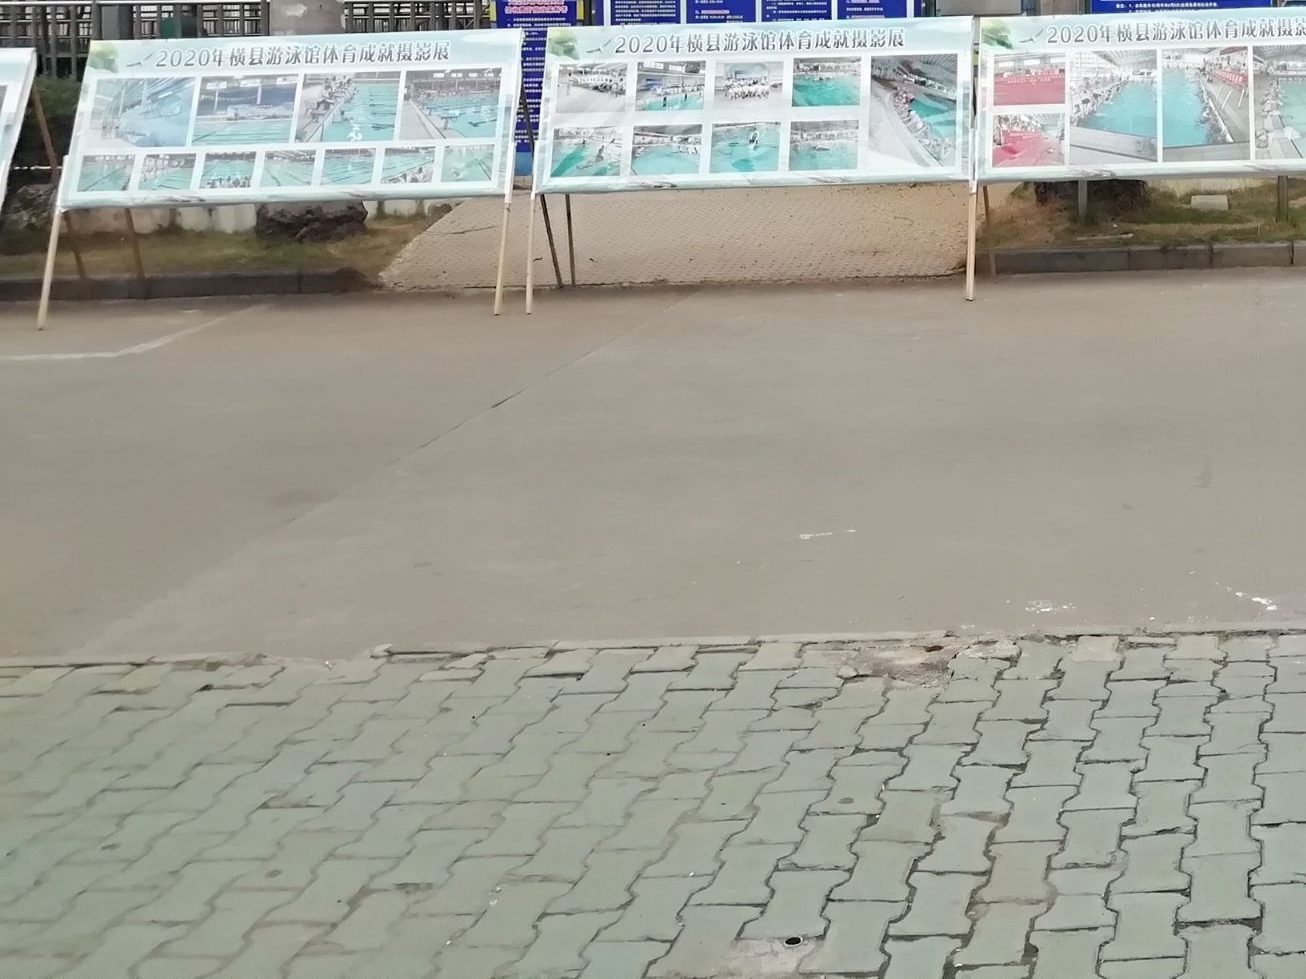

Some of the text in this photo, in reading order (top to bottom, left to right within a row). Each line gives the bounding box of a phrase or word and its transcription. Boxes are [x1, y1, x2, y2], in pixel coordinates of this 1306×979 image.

[156, 41, 449, 68] 2020年横县游泳馆体育成就摄影展
[615, 29, 905, 54] 2020年横县游泳馆体育成就摄影展
